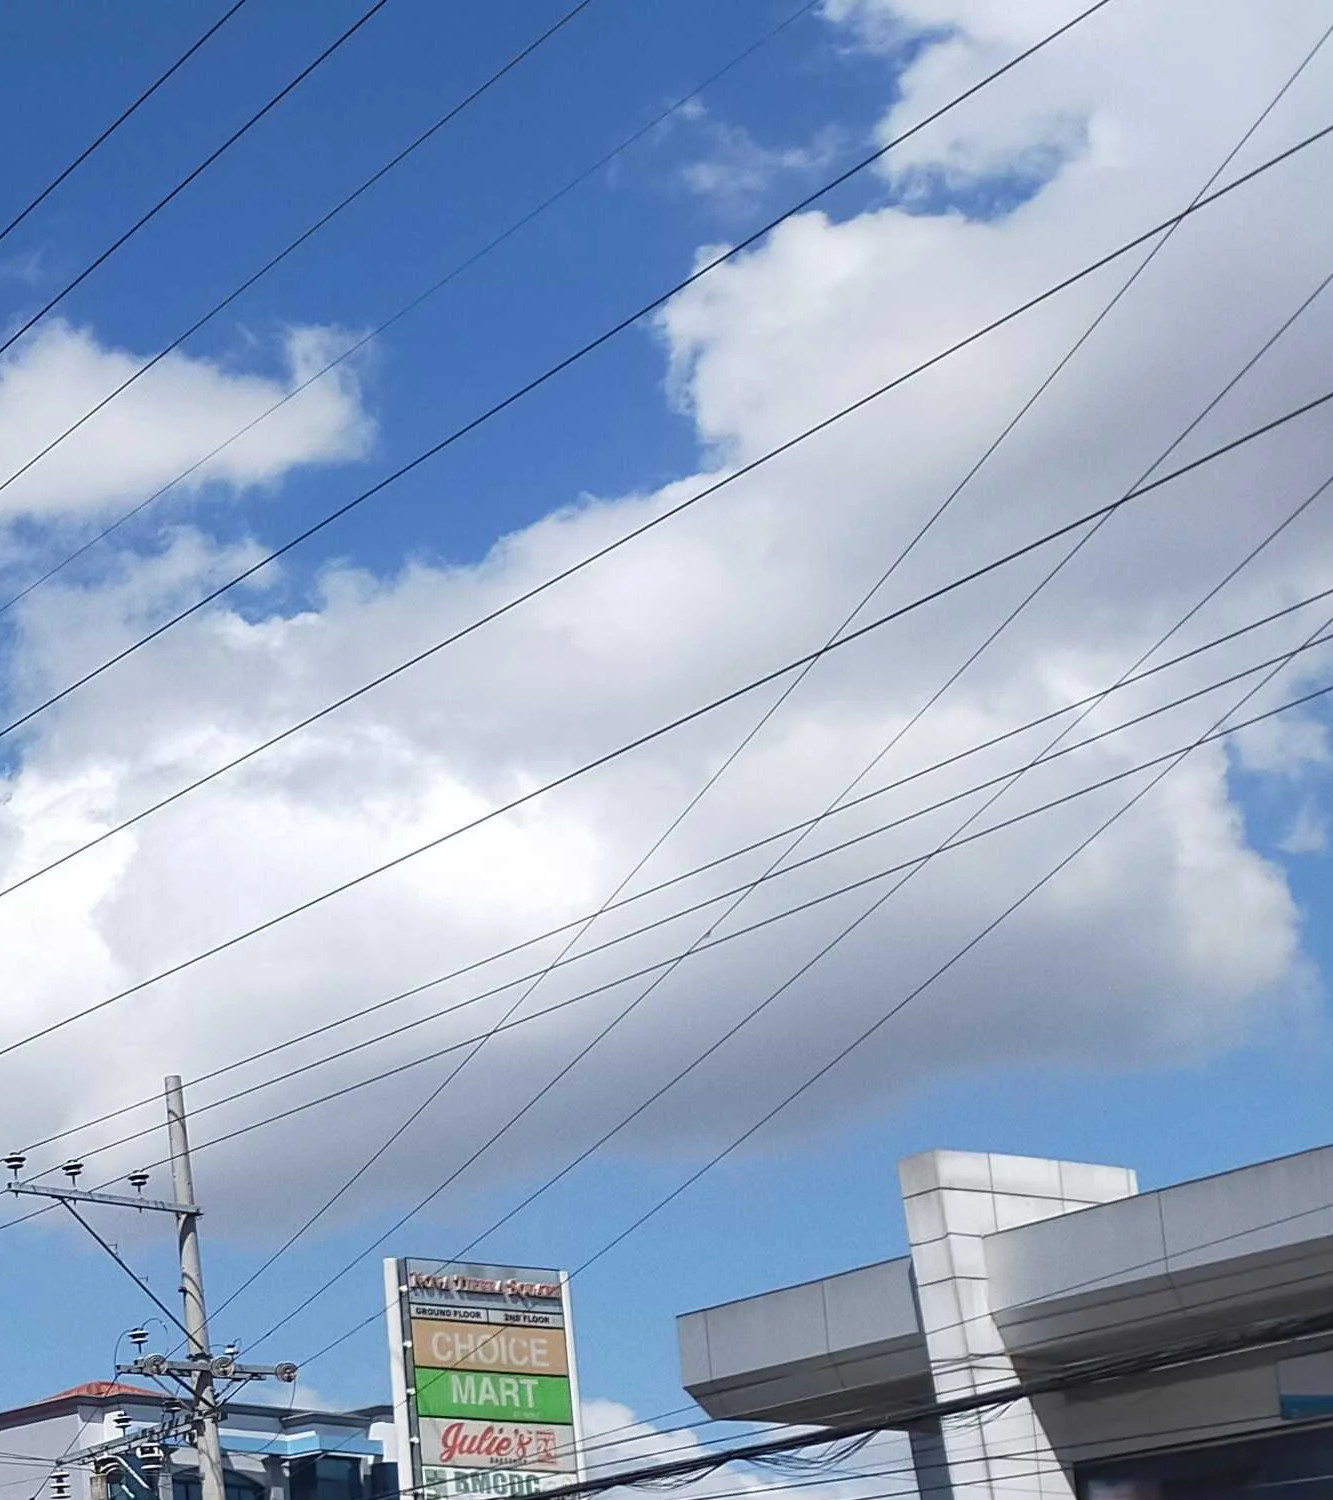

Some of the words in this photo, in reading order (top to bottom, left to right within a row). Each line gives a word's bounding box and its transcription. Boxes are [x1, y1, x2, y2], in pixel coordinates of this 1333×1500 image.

[415, 1307, 451, 1317] GROUND
[453, 1310, 482, 1319] FLOOR
[522, 1315, 549, 1323] FLOOR
[432, 1331, 549, 1367] CHOICE
[451, 1374, 539, 1408] MART
[439, 1422, 532, 1463] Julie's
